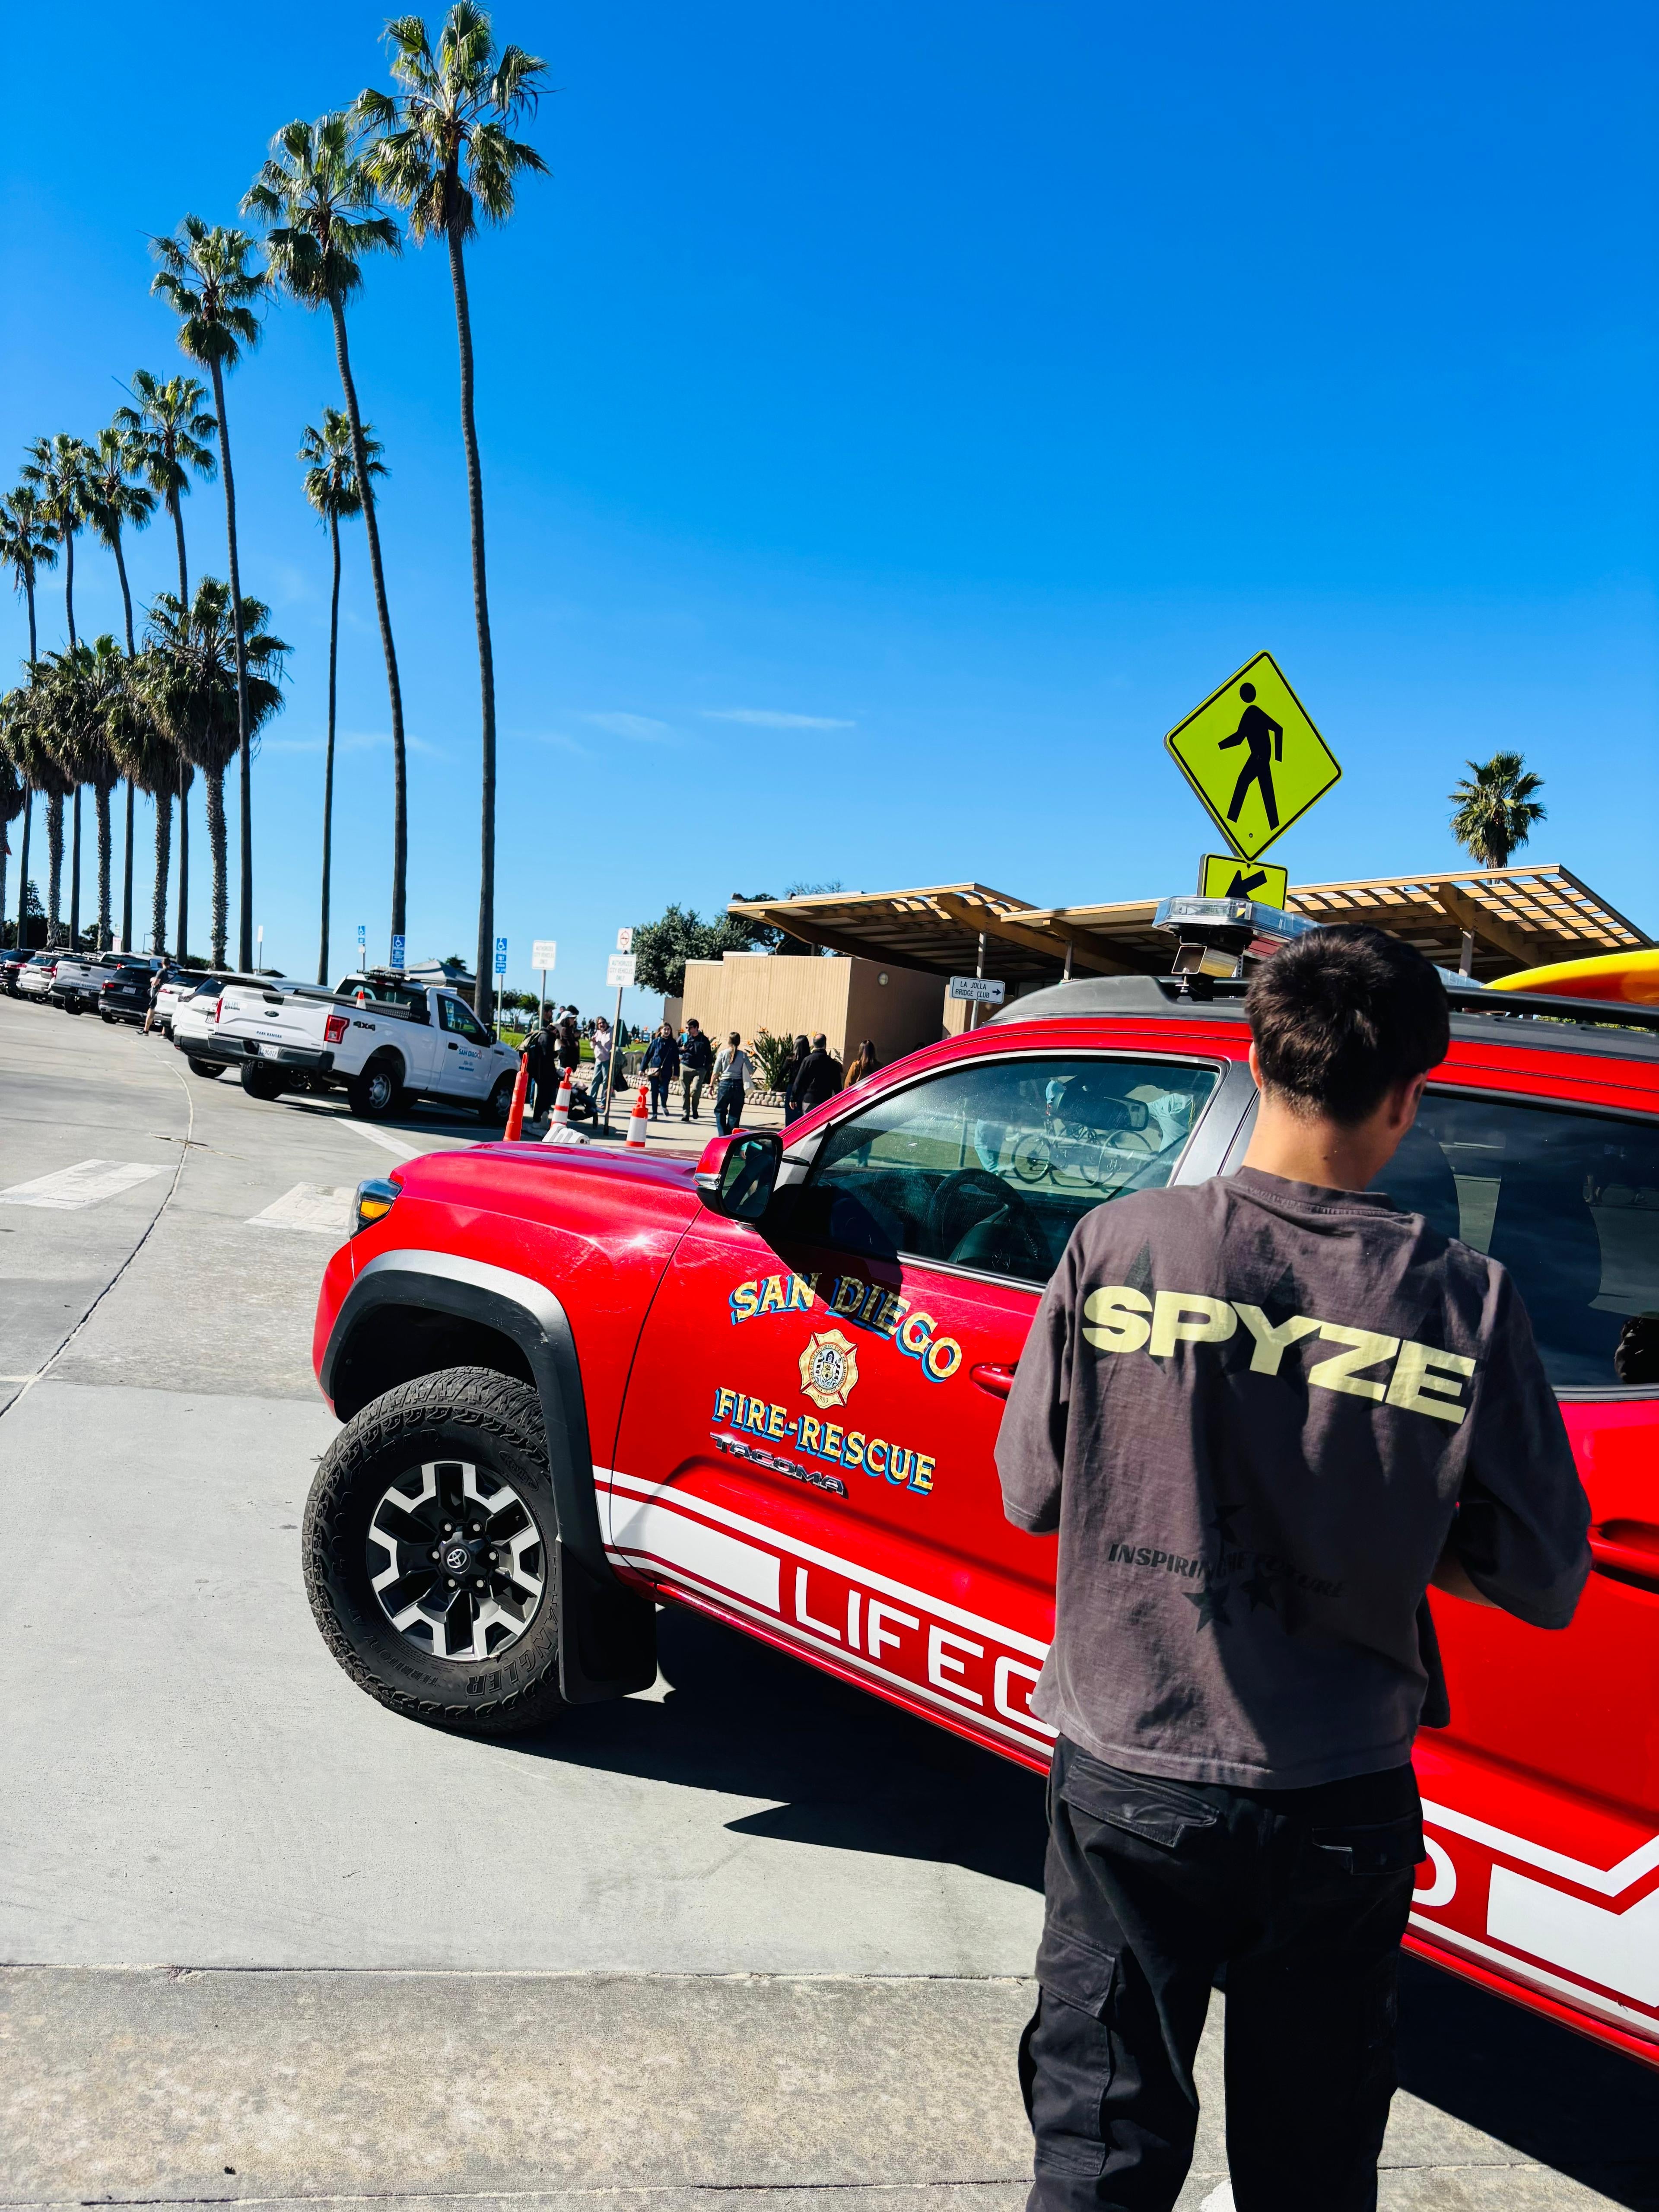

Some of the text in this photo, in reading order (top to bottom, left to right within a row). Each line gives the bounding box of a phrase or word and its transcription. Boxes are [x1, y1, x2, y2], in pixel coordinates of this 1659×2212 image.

[955, 988, 974, 997] BRIDGE
[468, 1050, 482, 1059] DIEGO
[730, 1273, 962, 1382] SAN DIEGO
[1082, 1285, 1477, 1425] SPYZE
[817, 1394, 829, 1404] 1889
[710, 1432, 847, 1497] TACOMA
[712, 1387, 936, 1495] FIRE-RESCUE
